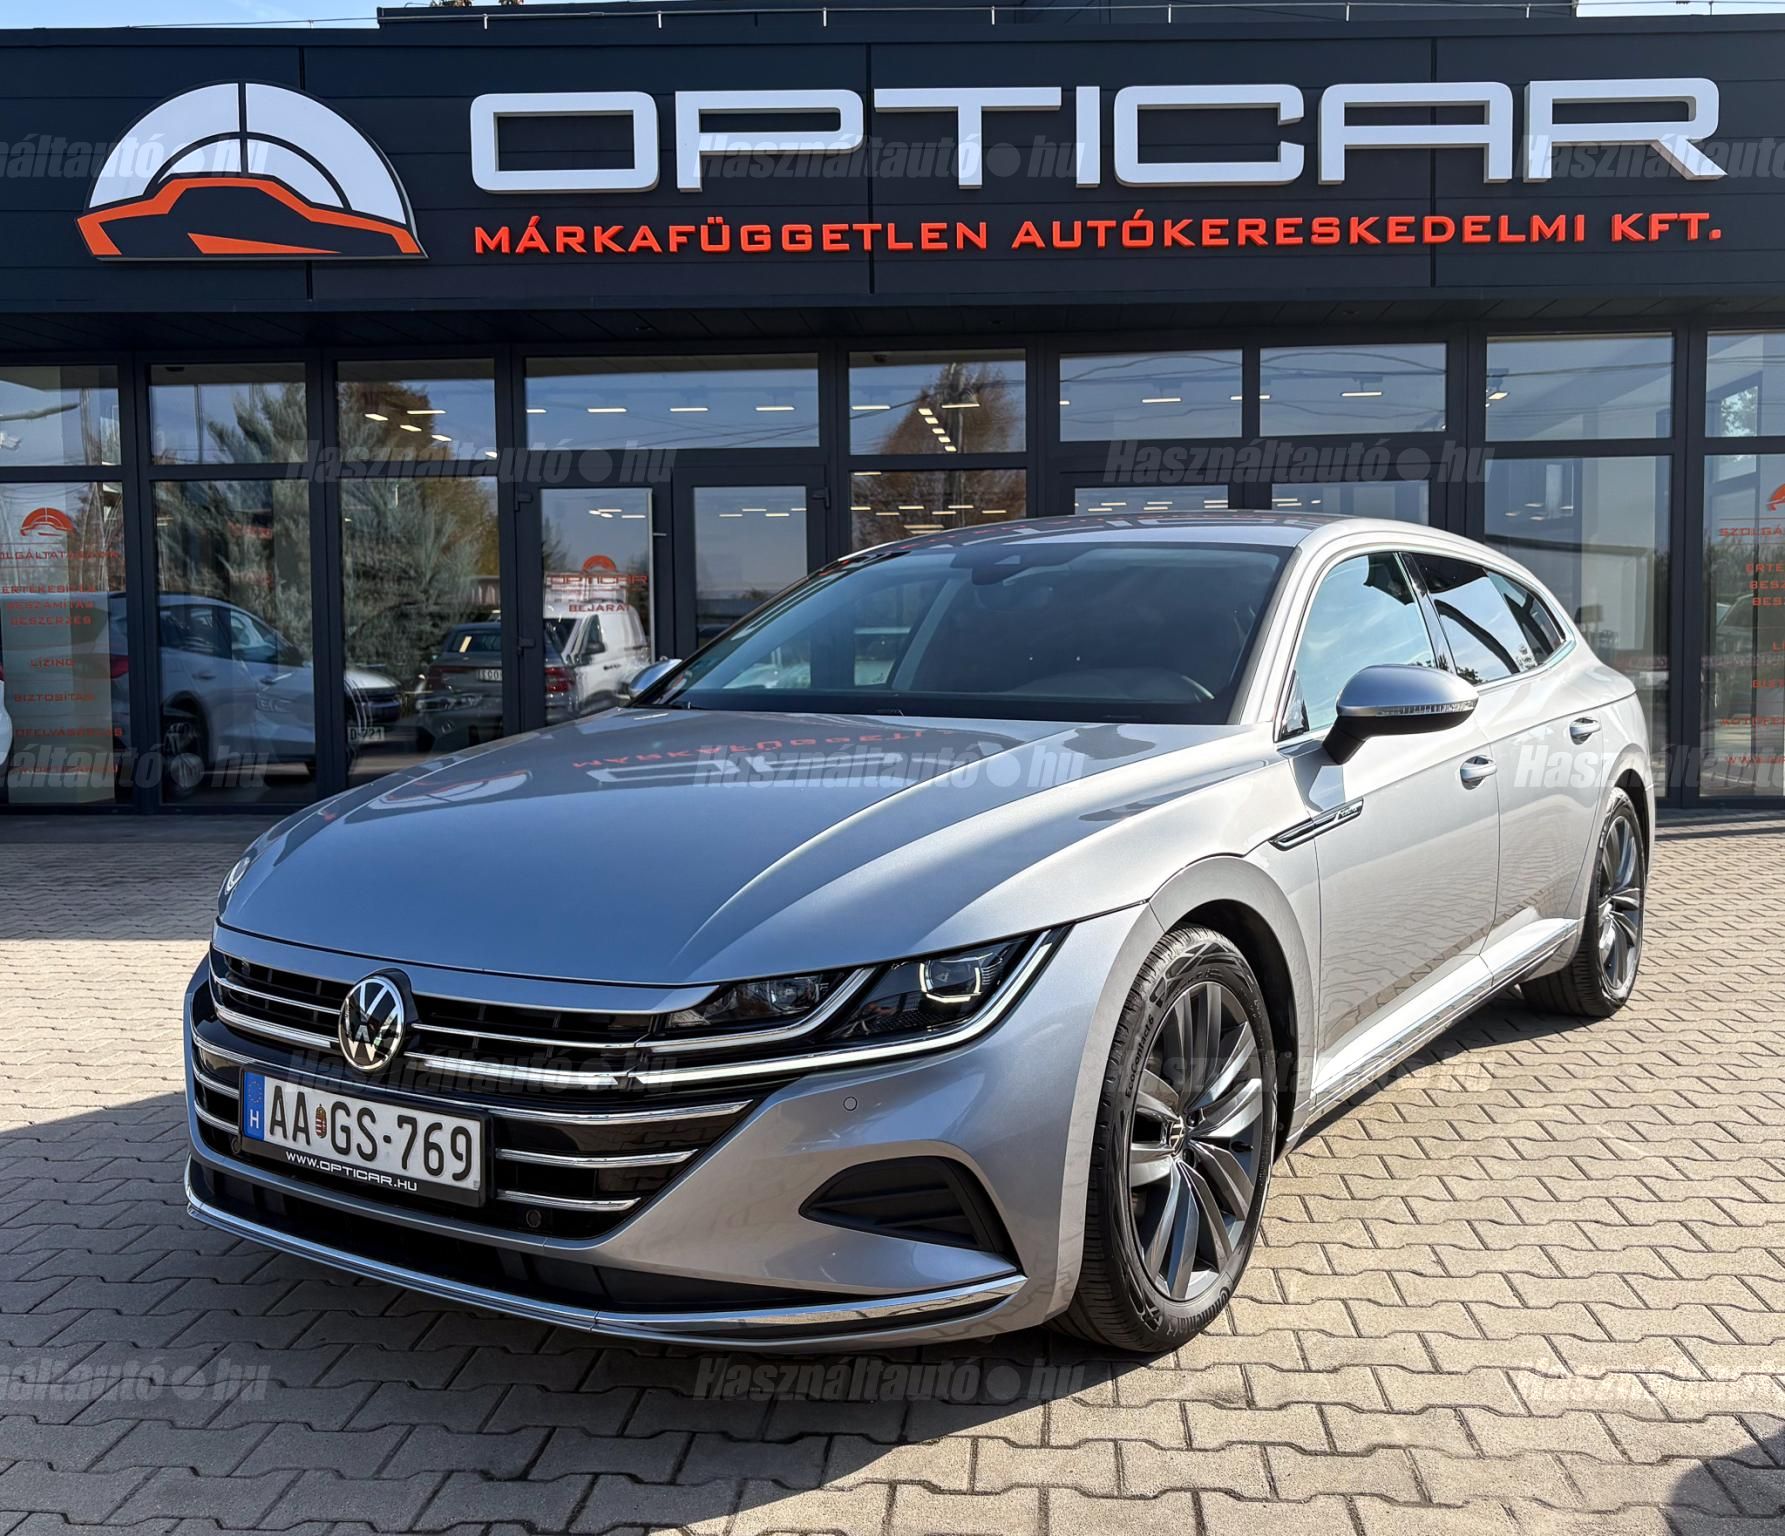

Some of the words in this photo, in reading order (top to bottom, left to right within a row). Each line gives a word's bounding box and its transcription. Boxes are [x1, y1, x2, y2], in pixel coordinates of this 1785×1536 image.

[470, 77, 1728, 193] OPTICAR
[474, 214, 989, 254] MÁRKAFÜGGETLEN
[1011, 208, 1586, 249] AUTÓKERESKEDELMI
[1611, 212, 1722, 242] KFT.
[250, 1111, 259, 1128] H
[286, 1151, 418, 1191] WWW.OPTICAR.HU
